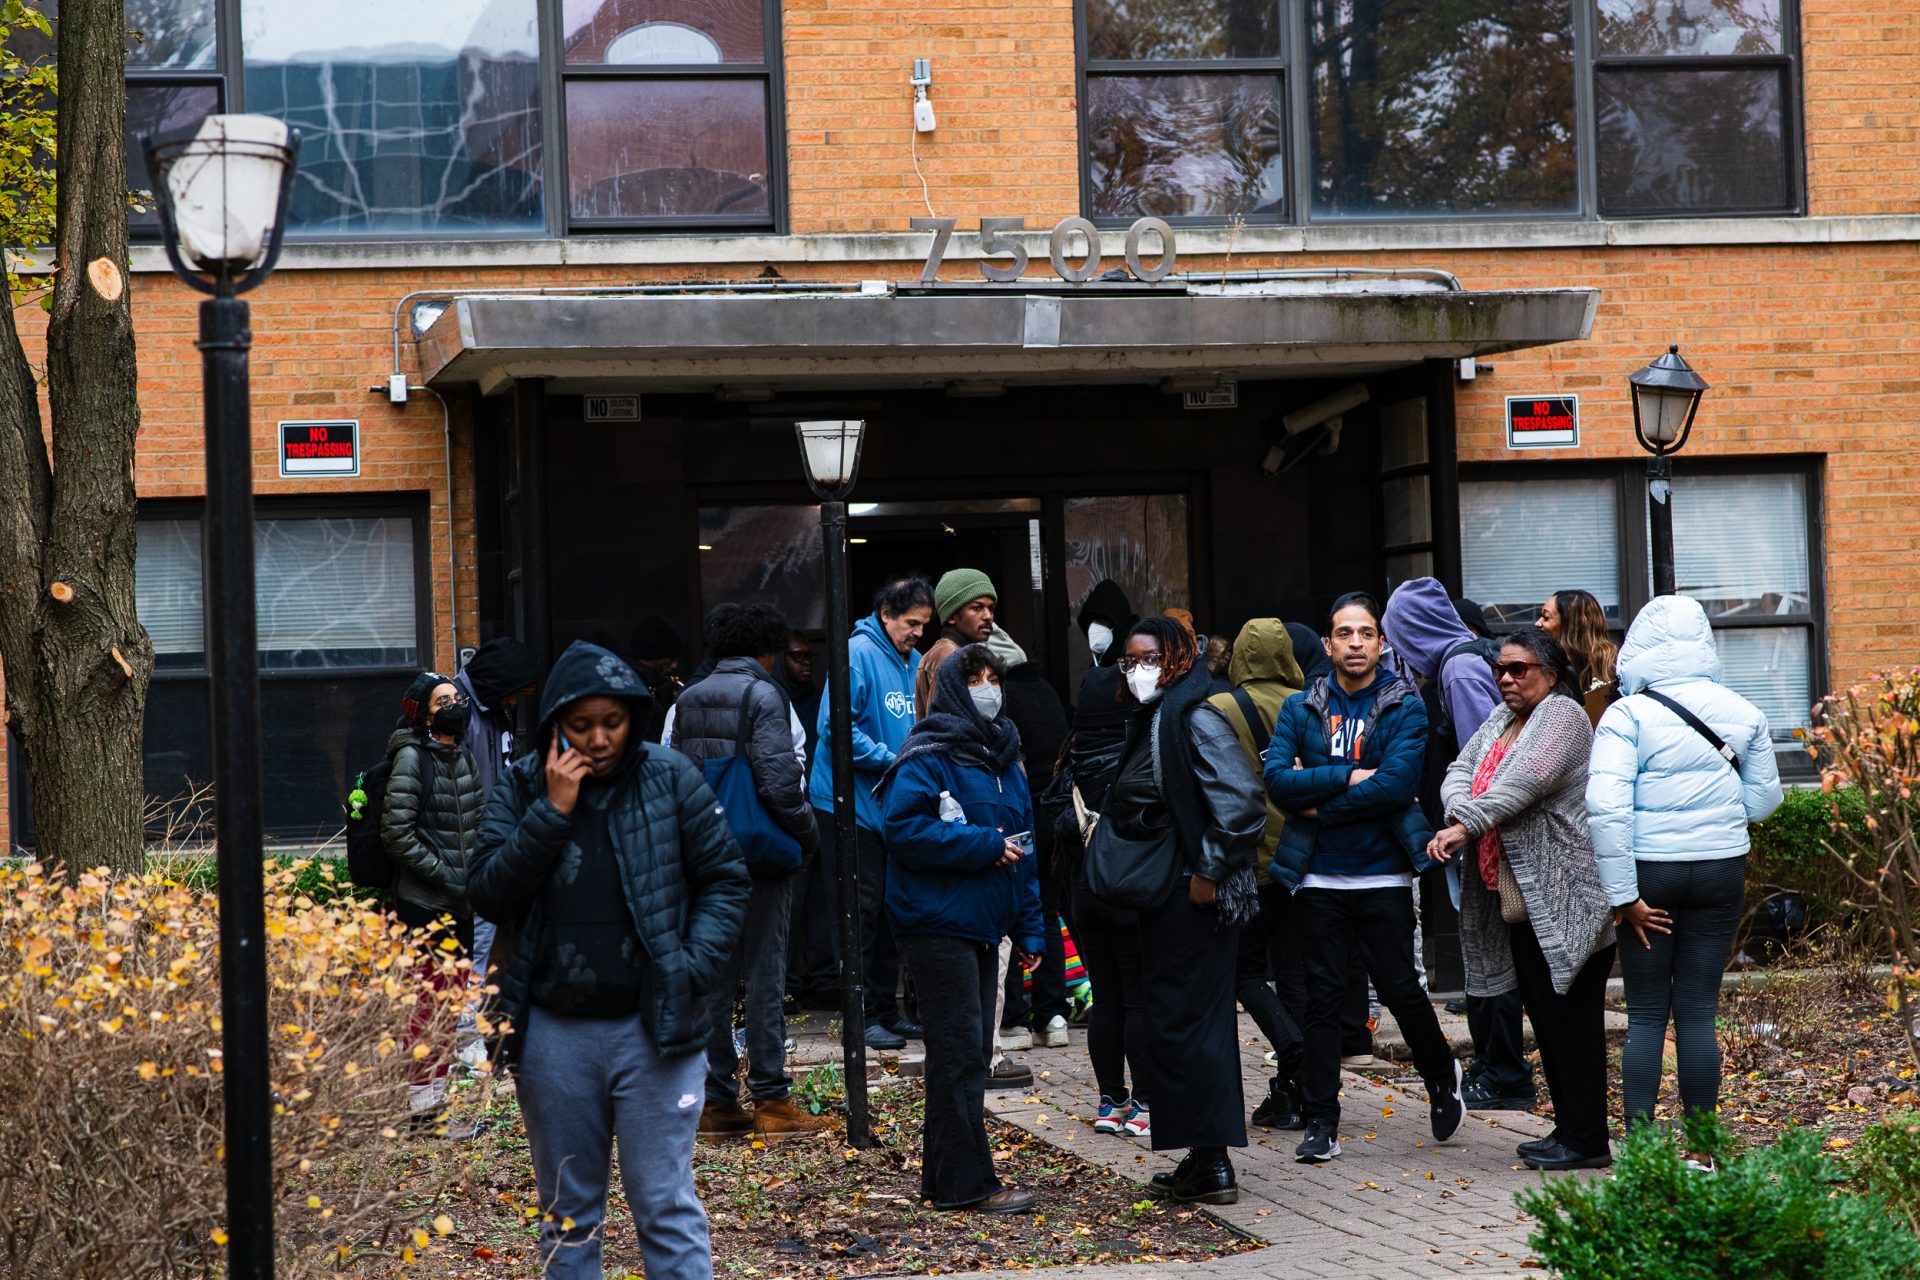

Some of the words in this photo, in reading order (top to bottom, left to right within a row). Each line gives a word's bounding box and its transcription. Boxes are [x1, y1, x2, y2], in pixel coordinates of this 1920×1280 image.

[910, 216, 1176, 283] 7500
[590, 399, 607, 417] NO
[1533, 401, 1550, 416] NO
[1512, 415, 1573, 431] TRESPASSING
[309, 426, 328, 442] NO
[285, 441, 353, 458] TRESPASSING
